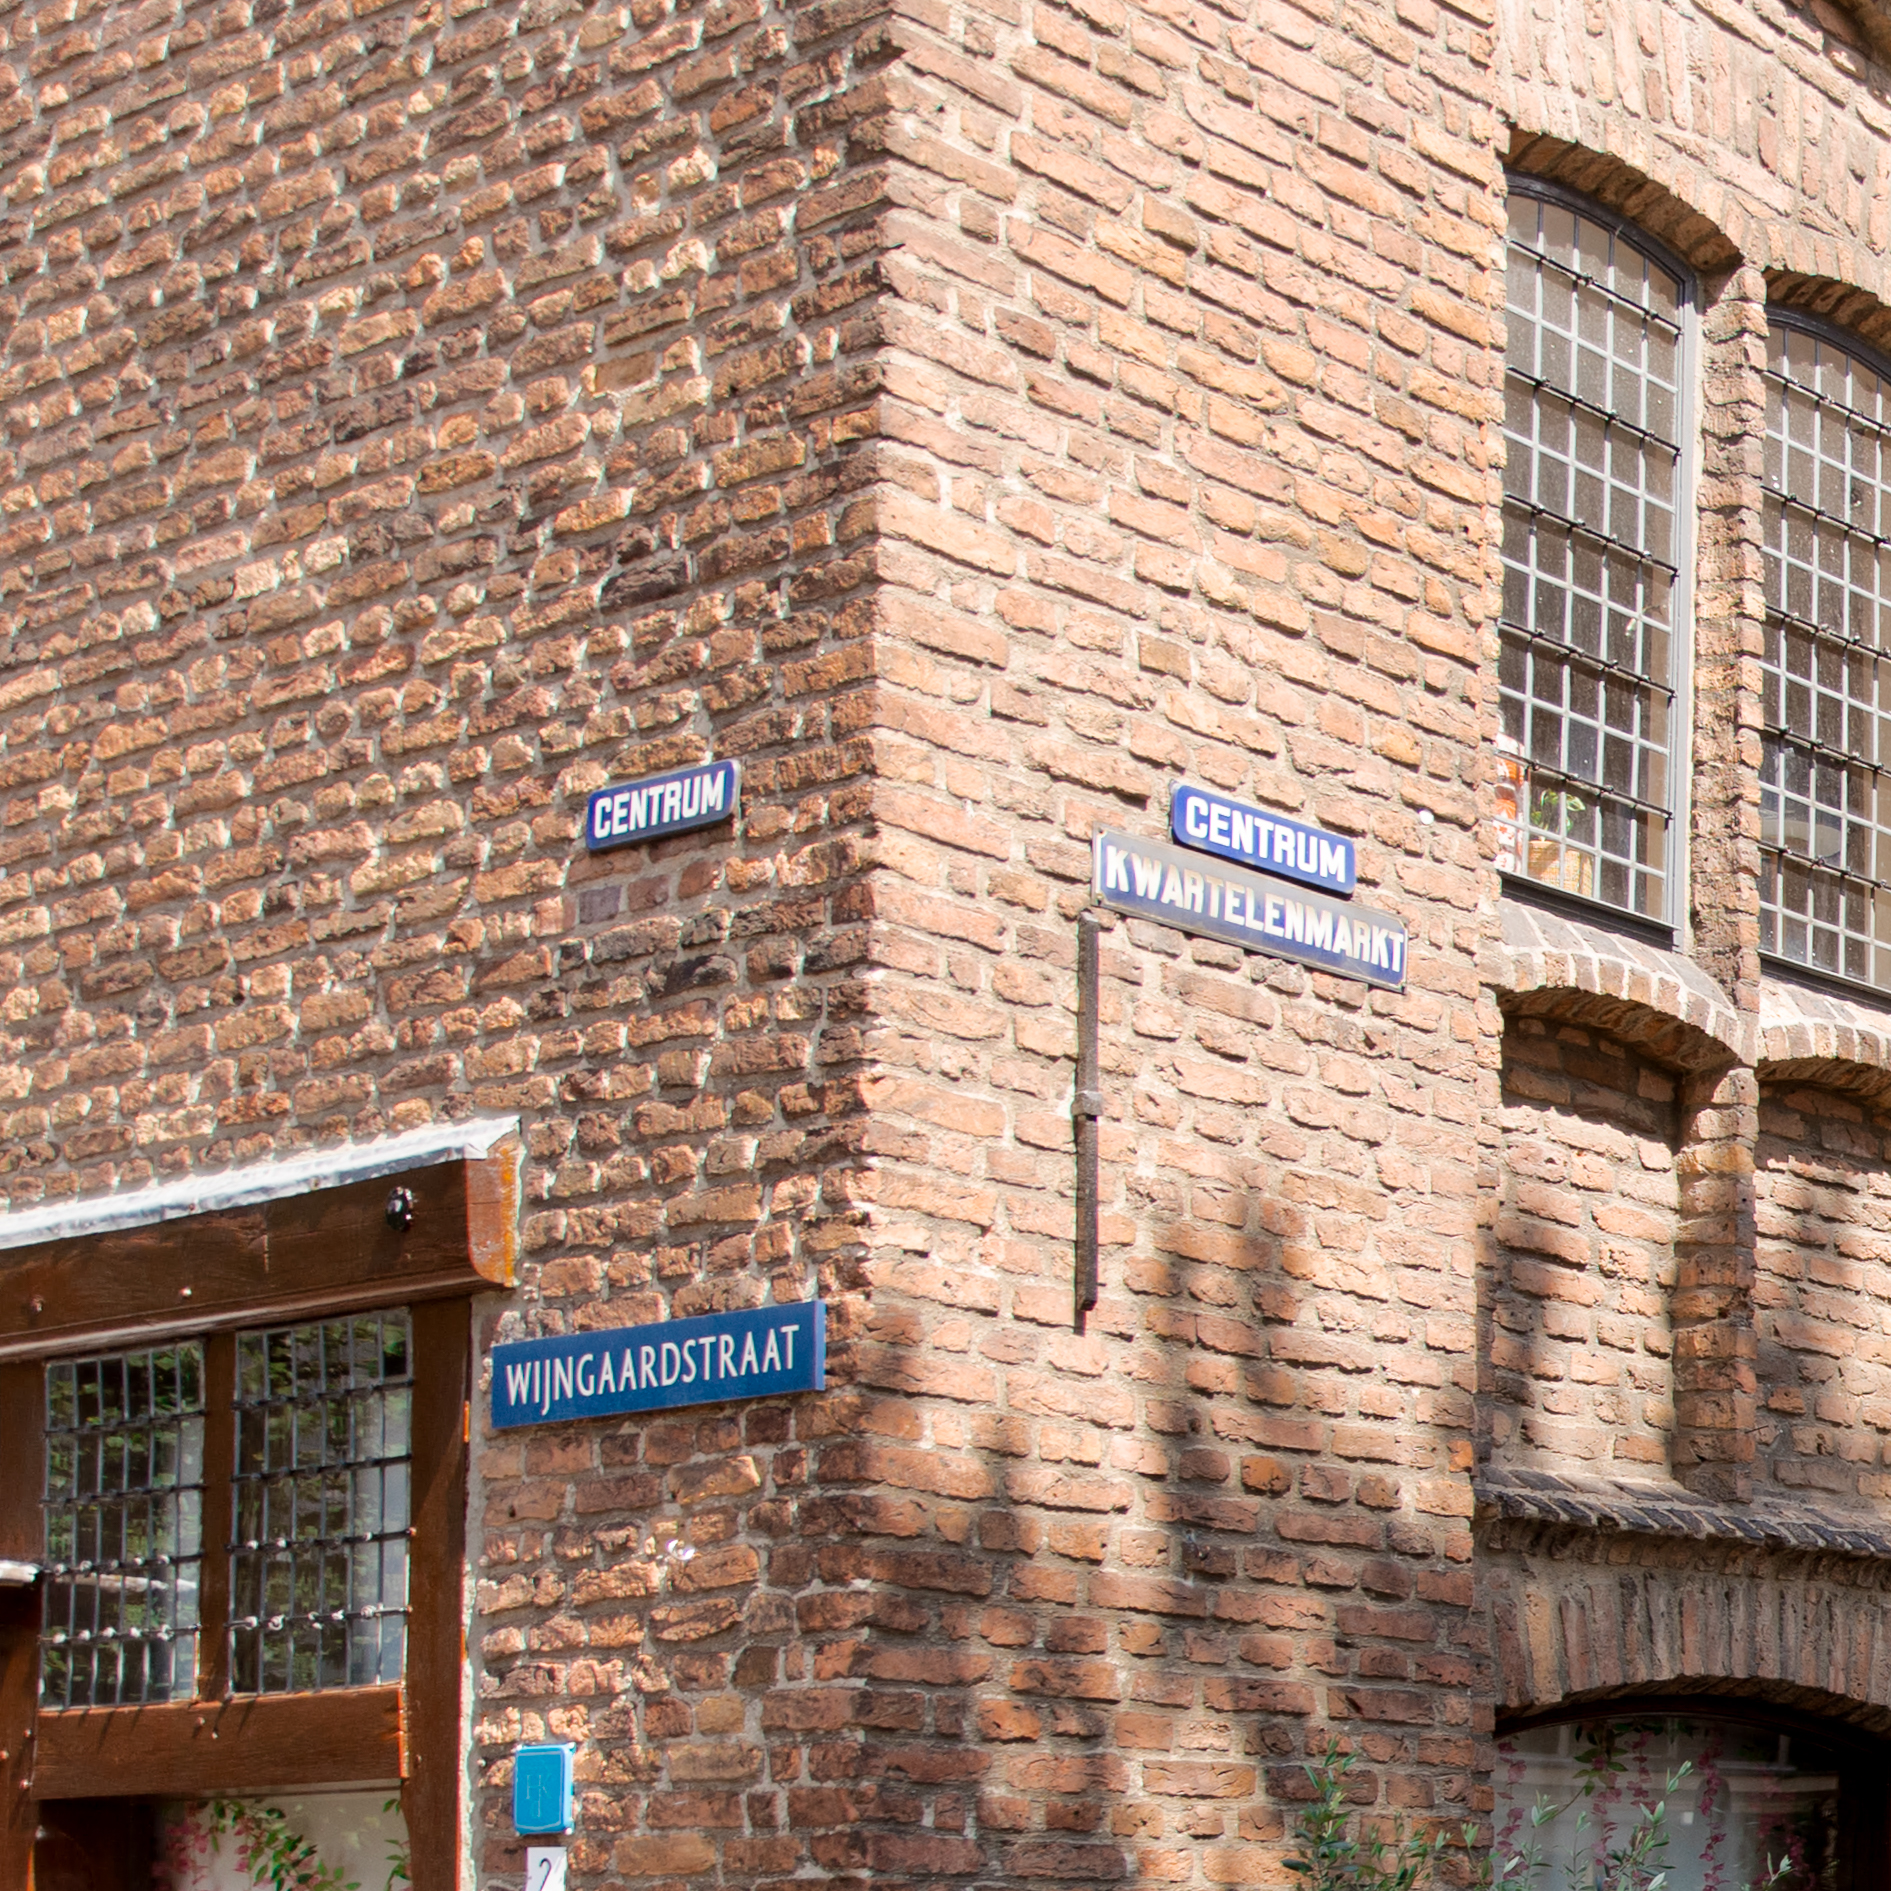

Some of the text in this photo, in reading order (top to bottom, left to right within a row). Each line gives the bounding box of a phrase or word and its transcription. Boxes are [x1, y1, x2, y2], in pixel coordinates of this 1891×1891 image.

[592, 768, 727, 841] CENTRUM
[1184, 795, 1347, 884] CENTRUM
[1104, 846, 1406, 976] KWARTELENMARKT
[505, 1323, 799, 1416] WIJNGAARDSTRAAT
